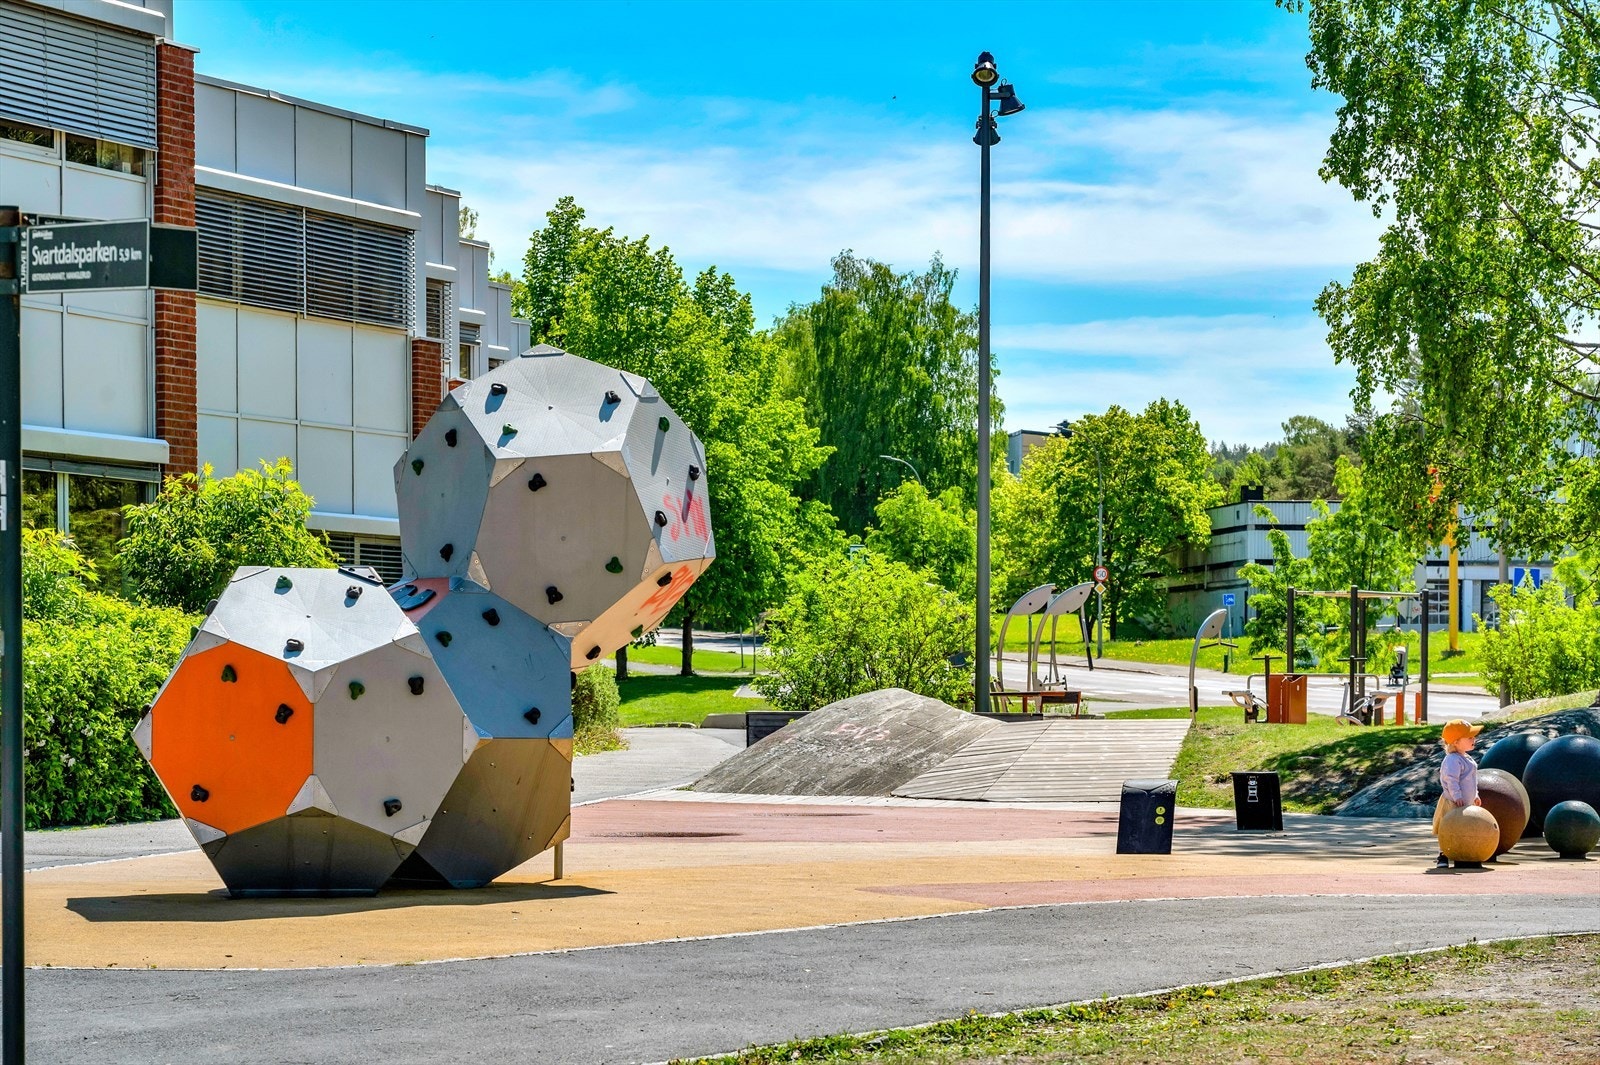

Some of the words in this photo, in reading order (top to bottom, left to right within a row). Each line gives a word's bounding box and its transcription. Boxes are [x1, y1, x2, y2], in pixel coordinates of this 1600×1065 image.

[32, 240, 117, 268] Svartdalsparken
[119, 248, 130, 262] 5,9
[131, 248, 142, 260] km
